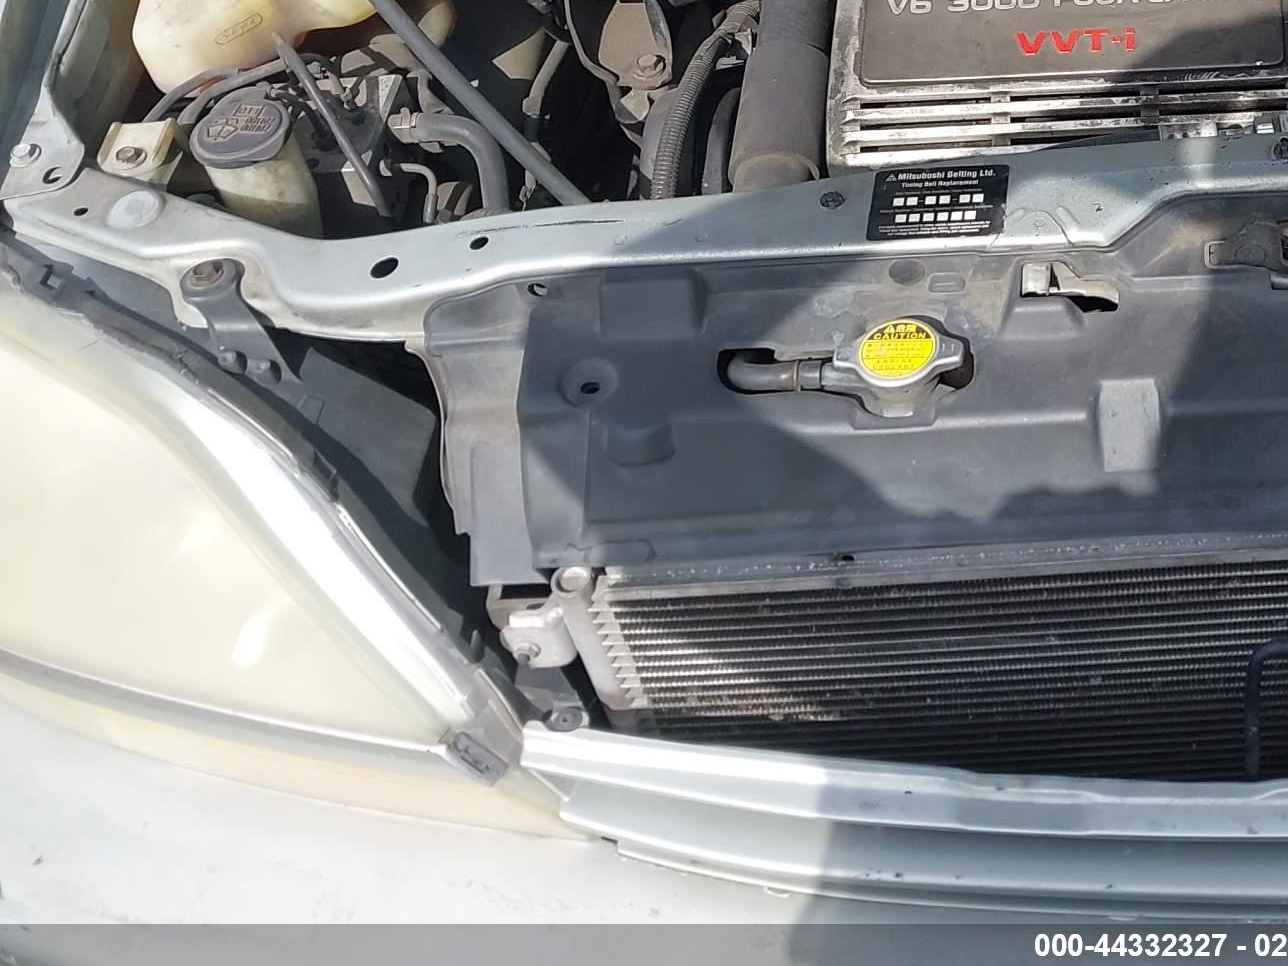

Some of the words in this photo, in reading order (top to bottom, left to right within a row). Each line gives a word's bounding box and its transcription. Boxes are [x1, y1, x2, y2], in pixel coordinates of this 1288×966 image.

[1015, 26, 1137, 56] VVT-i
[897, 171, 945, 181] Mitsuboshi
[947, 170, 978, 179] Belting
[979, 169, 997, 177] Ltd.
[938, 179, 979, 187] Replacement
[873, 332, 926, 340] CAUTION
